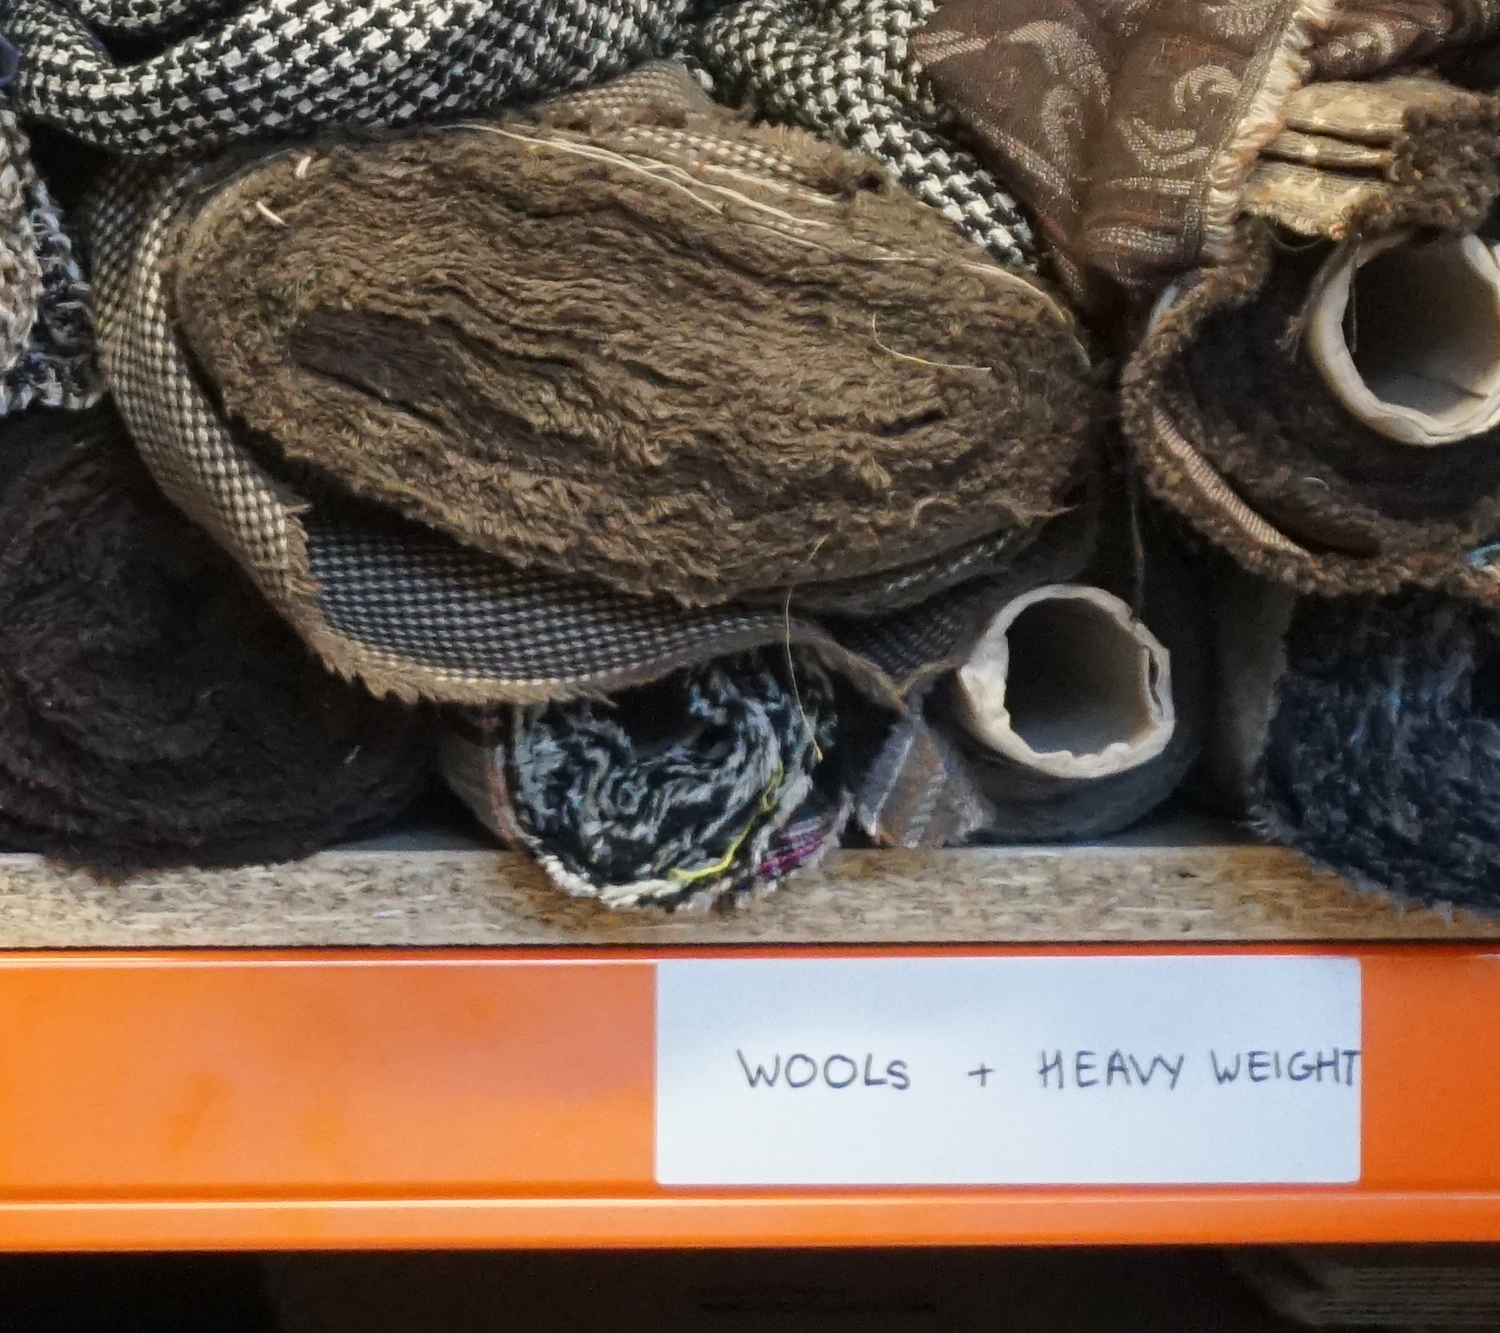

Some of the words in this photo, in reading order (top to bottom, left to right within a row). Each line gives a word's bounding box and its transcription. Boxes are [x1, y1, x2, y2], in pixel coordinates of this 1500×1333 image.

[736, 1048, 911, 1091] WOOLS
[967, 1062, 996, 1088] +
[1037, 1049, 1186, 1090] HEAVY
[1209, 1048, 1361, 1087] WEIGHT
